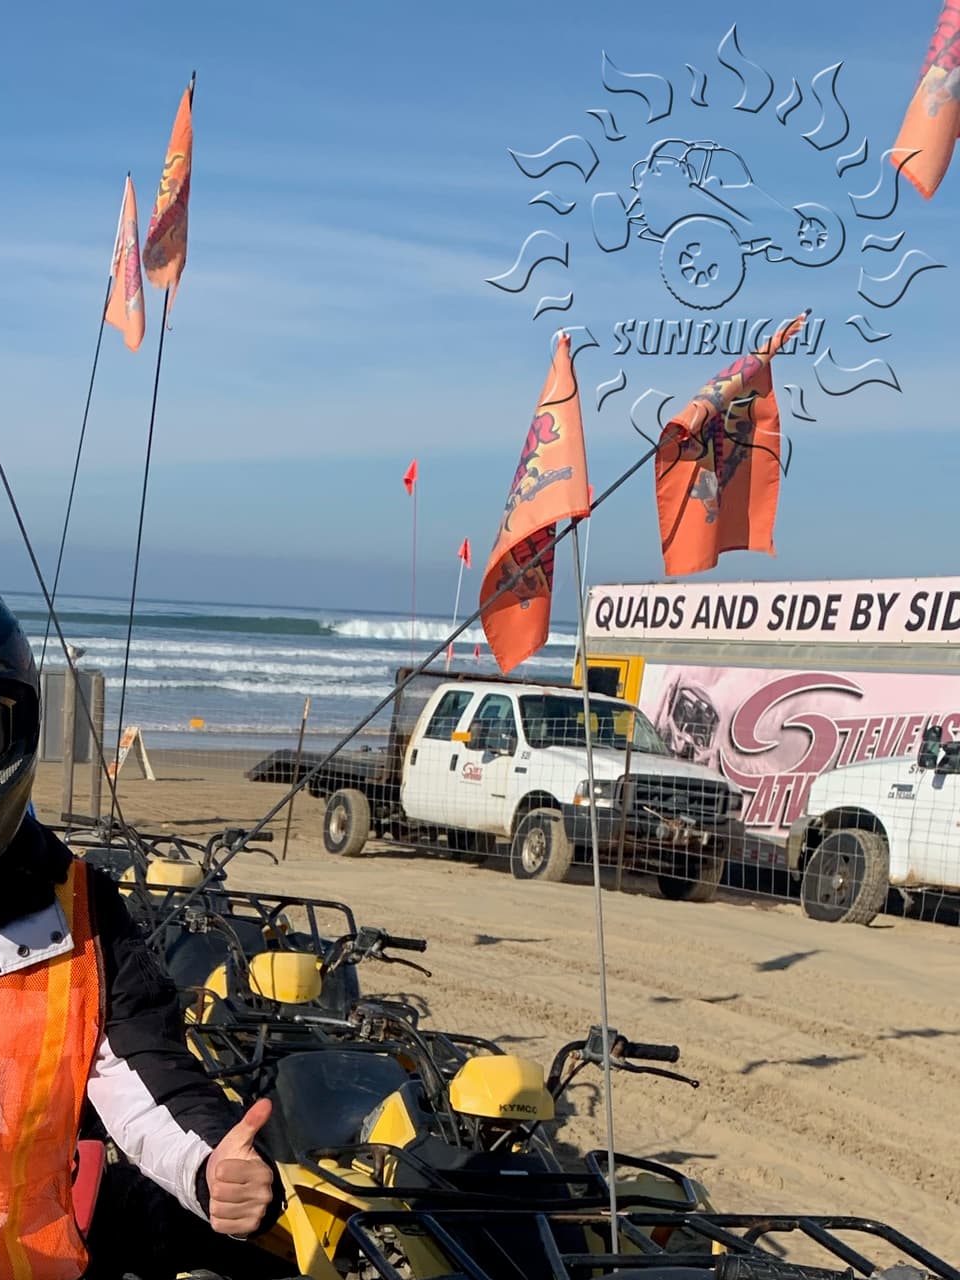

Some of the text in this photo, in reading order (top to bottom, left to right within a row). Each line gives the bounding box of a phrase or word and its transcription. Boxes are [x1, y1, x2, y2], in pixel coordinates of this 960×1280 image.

[595, 595, 686, 631] QUADS
[692, 594, 759, 630] AND
[767, 593, 842, 631] SIDE
[850, 592, 901, 631] BY
